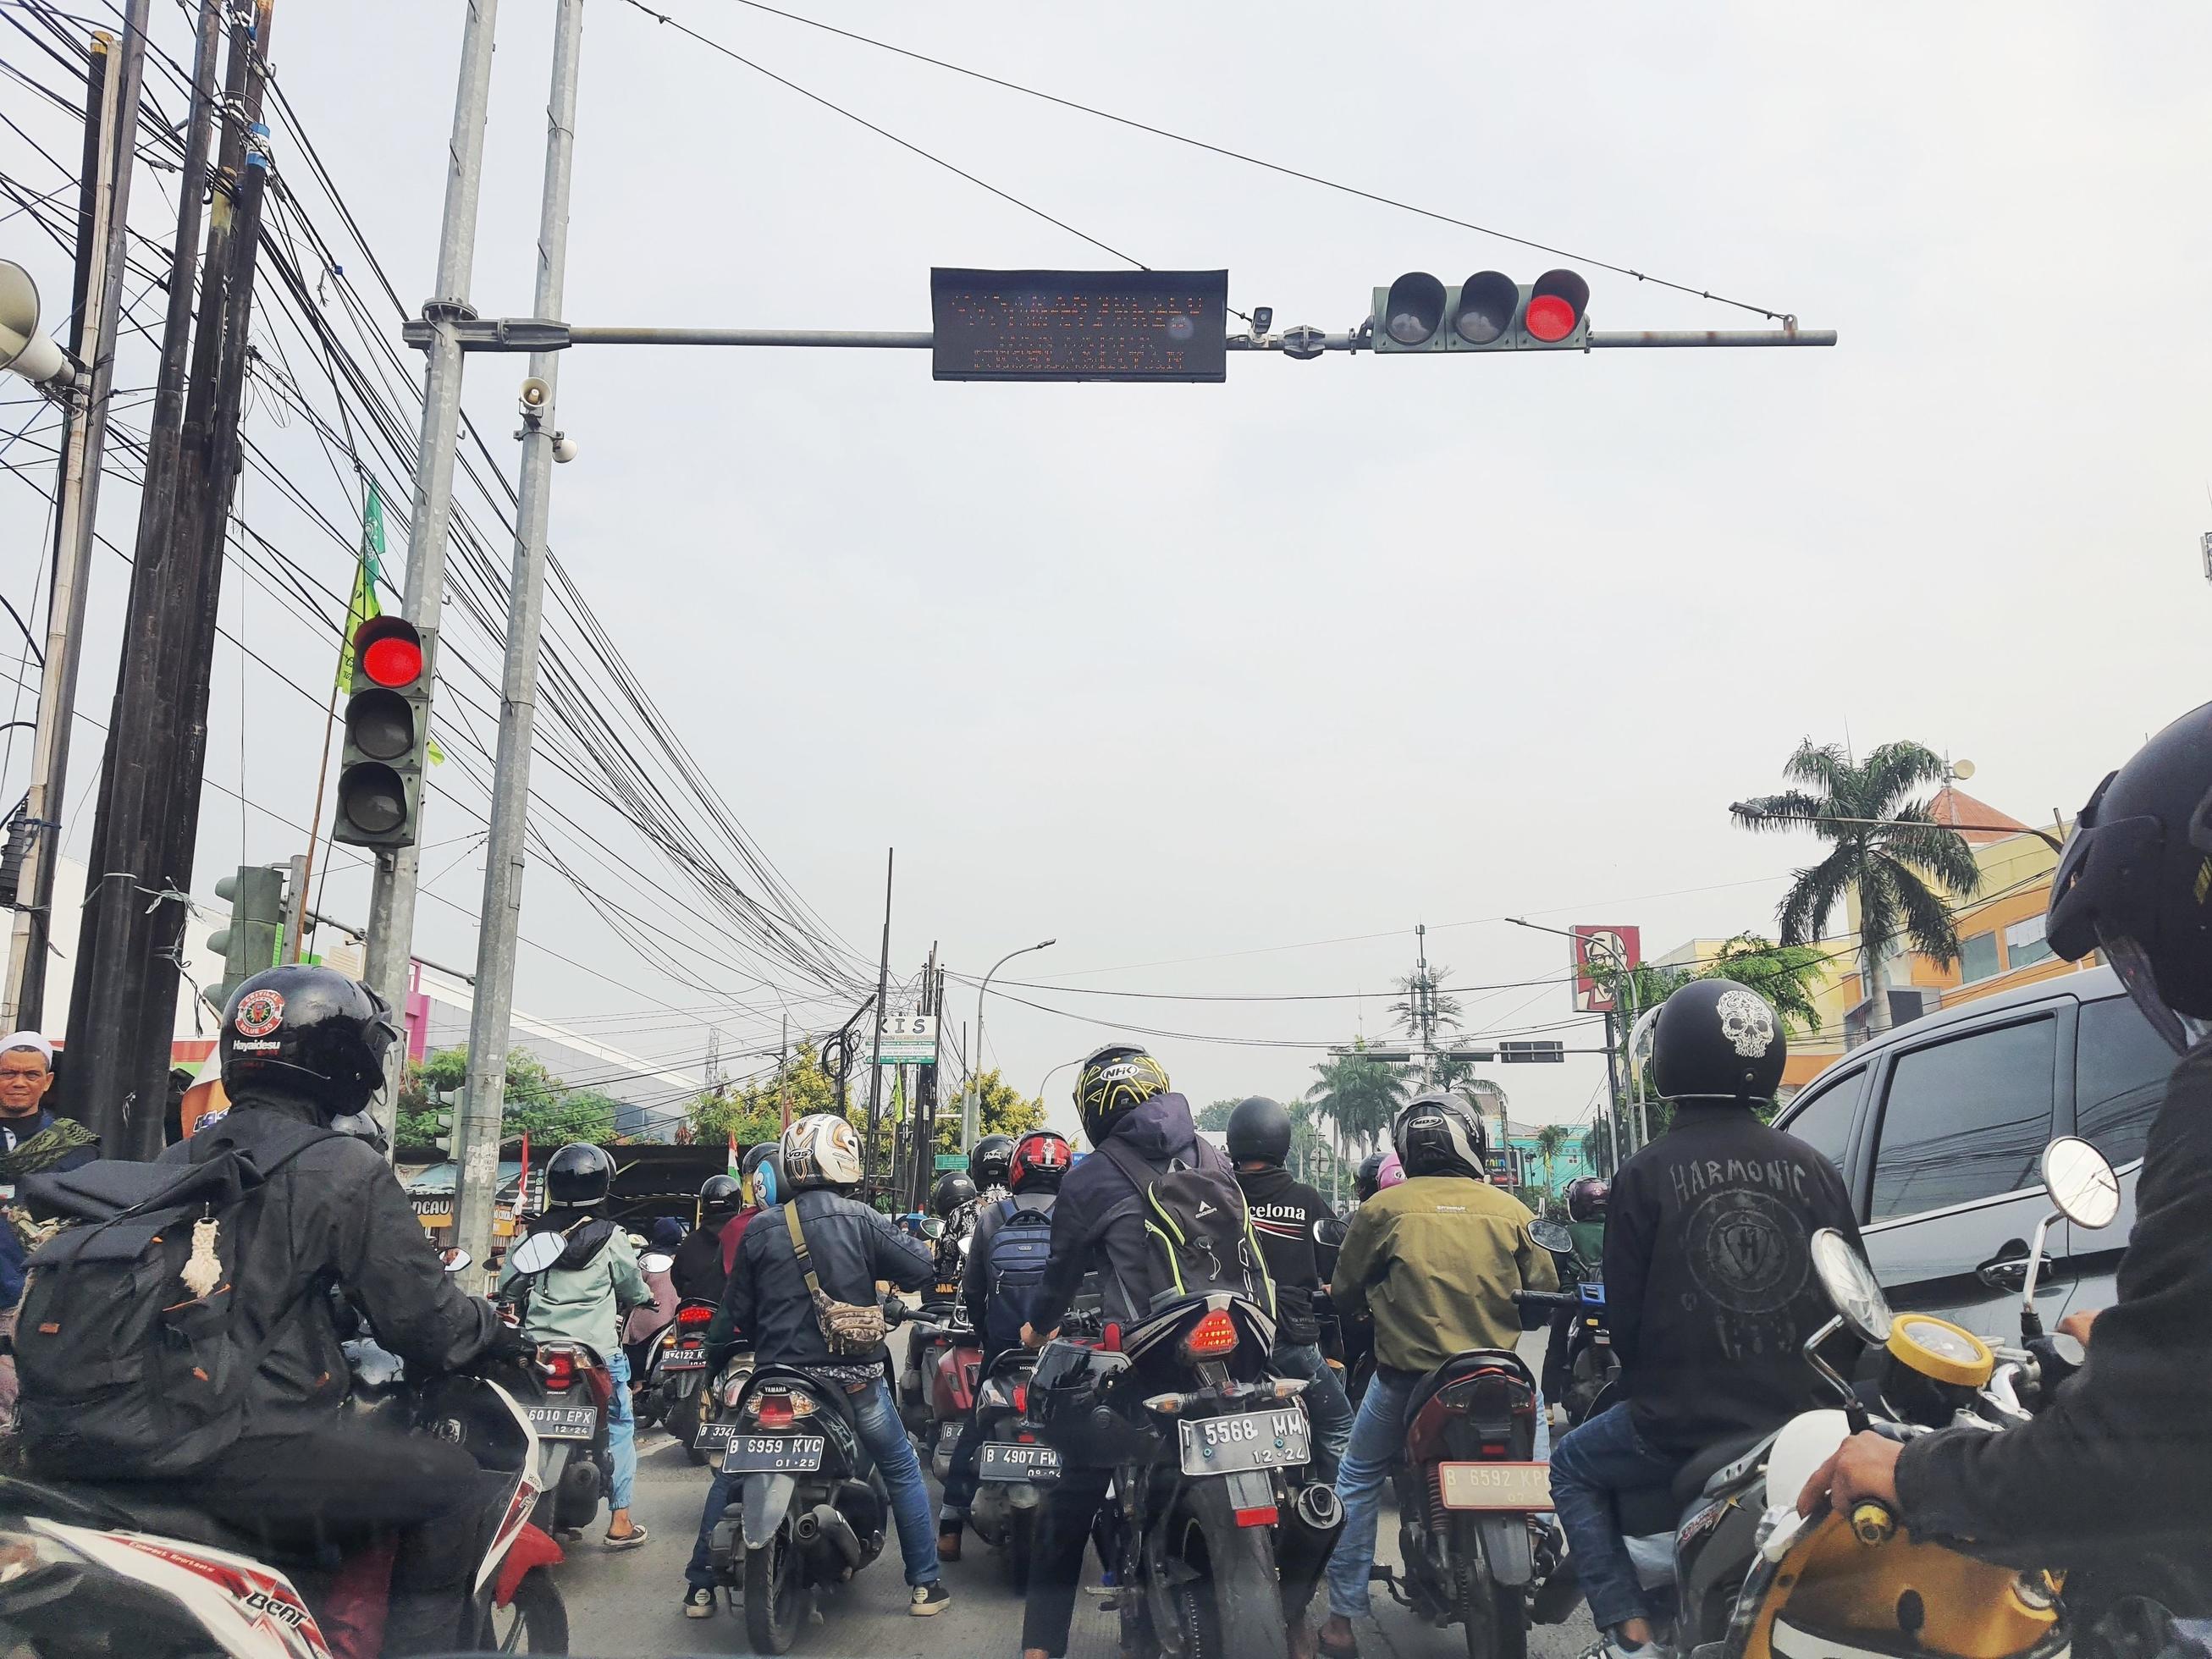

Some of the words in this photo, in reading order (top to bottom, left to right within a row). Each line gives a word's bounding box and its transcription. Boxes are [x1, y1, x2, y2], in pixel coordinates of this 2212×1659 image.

[233, 1039, 281, 1052] Hayaidesu
[1106, 1066, 1131, 1078] NHK
[1669, 1160, 1810, 1213] HARMONIC
[528, 1409, 560, 1422] 6010
[566, 1410, 592, 1425] EPX
[700, 1427, 708, 1436] B
[1205, 1419, 1257, 1445] 5568
[1271, 1414, 1303, 1437] MM
[729, 1439, 739, 1454] B
[792, 1439, 821, 1453] KVC
[986, 1449, 995, 1463] B
[1003, 1450, 1034, 1463] 4907
[1447, 1469, 1455, 1485] B
[1470, 1469, 1510, 1486] 6592
